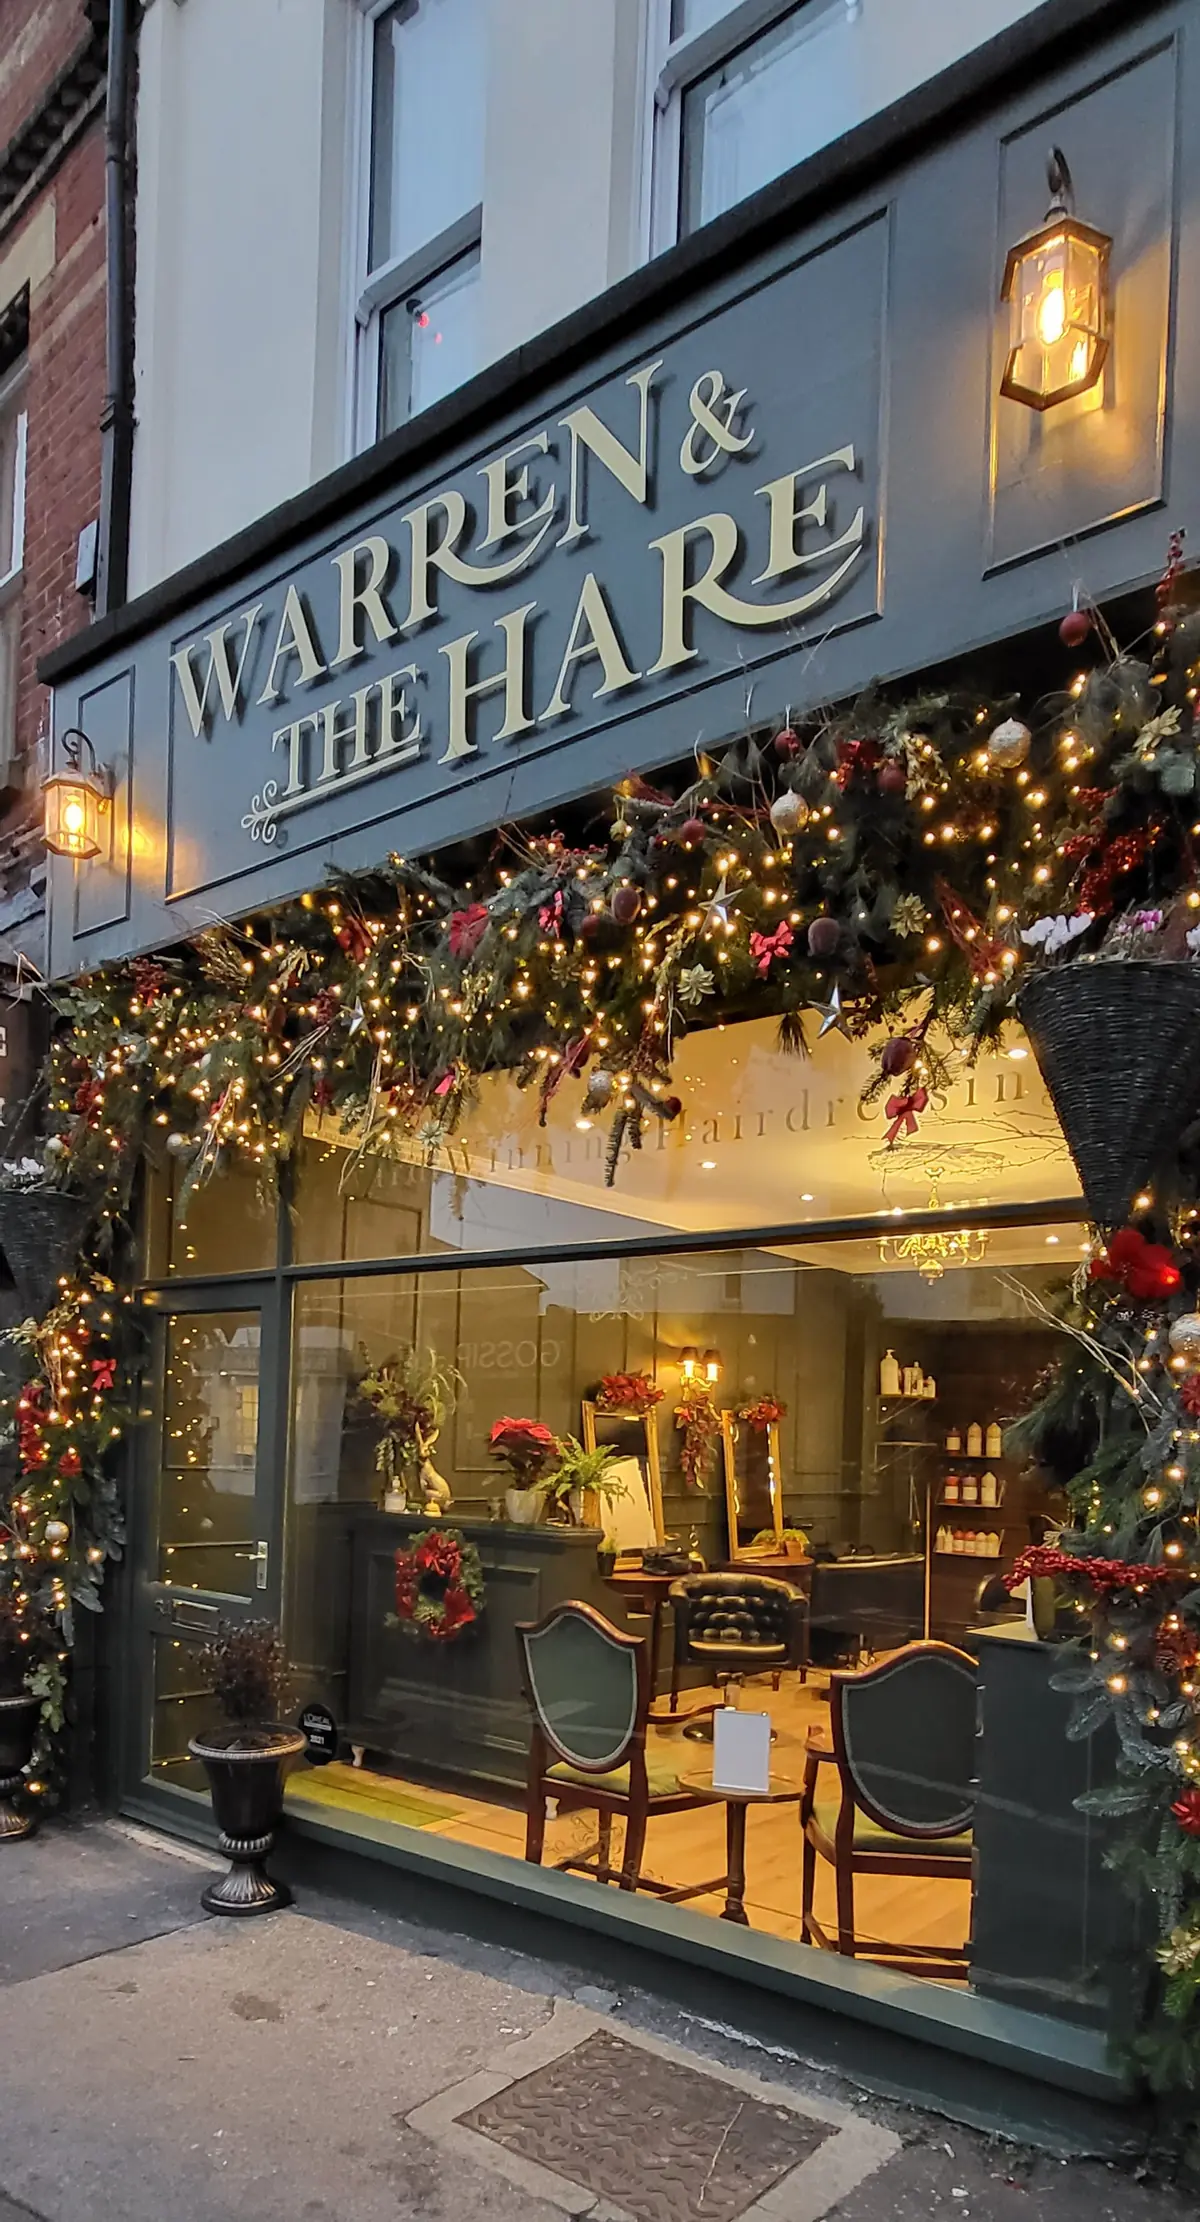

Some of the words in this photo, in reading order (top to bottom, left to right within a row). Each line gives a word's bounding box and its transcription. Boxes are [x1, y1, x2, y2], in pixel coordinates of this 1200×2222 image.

[169, 360, 663, 737] WARREN
[680, 370, 755, 475] &
[272, 664, 421, 798] THE
[437, 444, 864, 766] HARE
[656, 1068, 1056, 1150] Hairdresin
